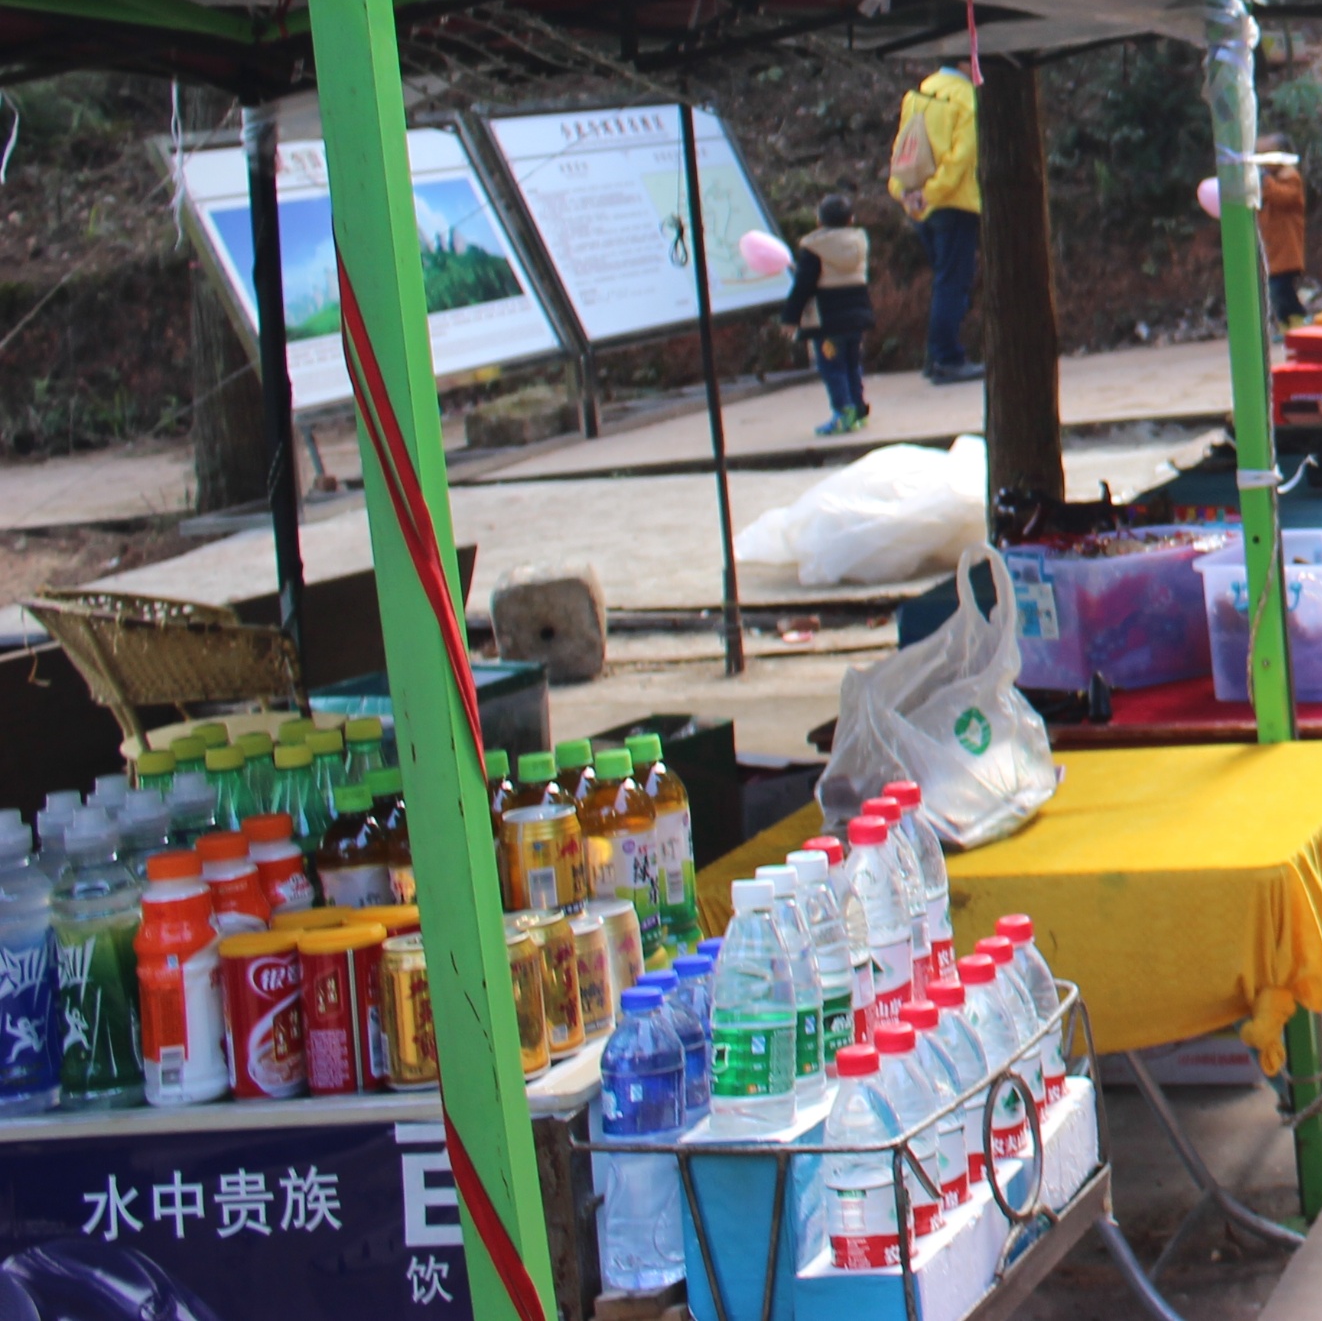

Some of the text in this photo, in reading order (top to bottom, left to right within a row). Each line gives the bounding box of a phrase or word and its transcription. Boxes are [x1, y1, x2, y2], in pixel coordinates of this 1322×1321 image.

[81, 1164, 343, 1242] 水中贵族
[406, 1254, 454, 1305] 饮
